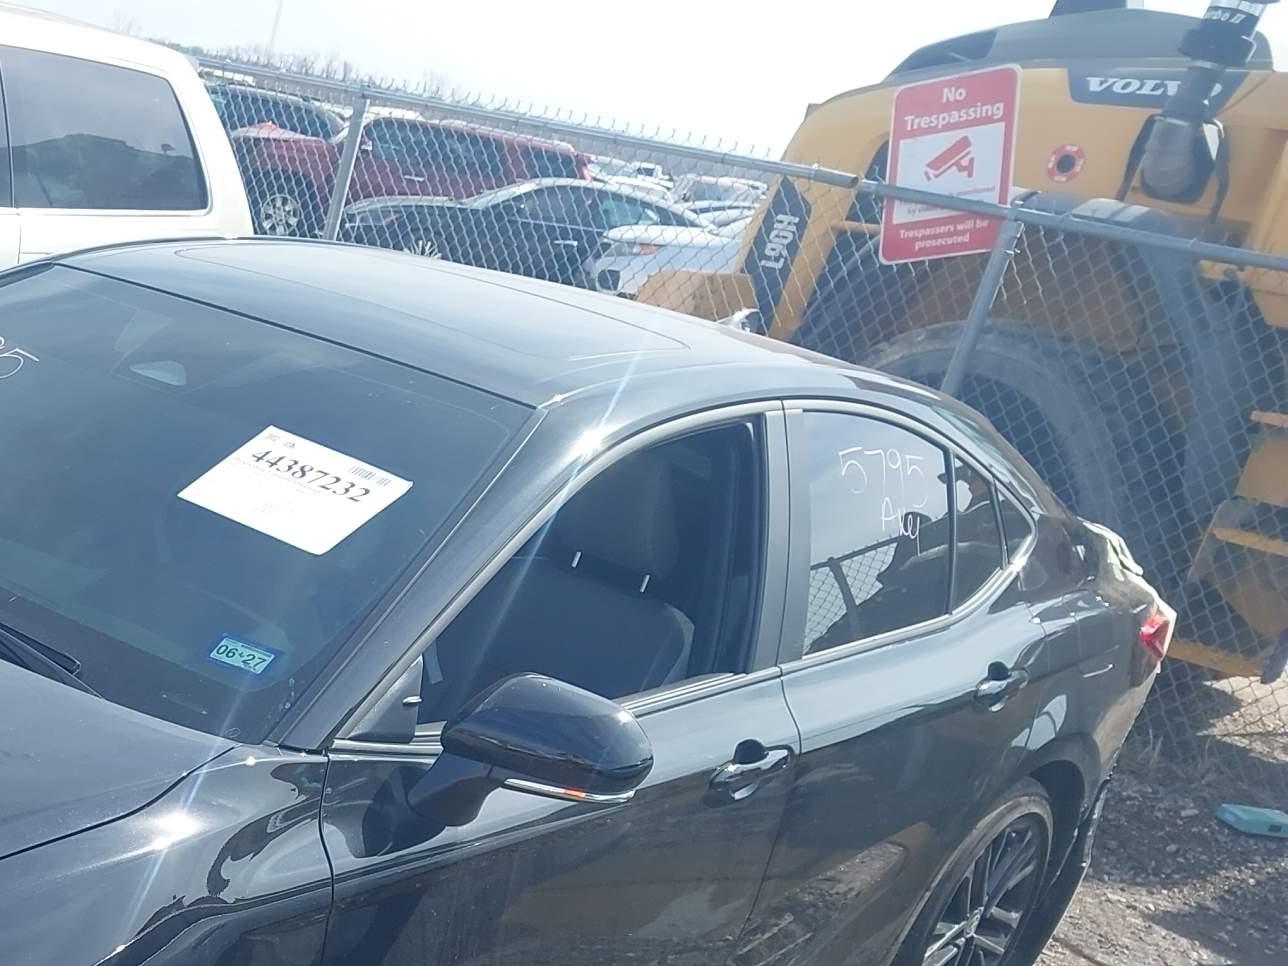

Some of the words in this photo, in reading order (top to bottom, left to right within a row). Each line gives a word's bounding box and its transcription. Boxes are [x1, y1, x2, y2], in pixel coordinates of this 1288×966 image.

[942, 86, 967, 103] No
[903, 102, 1005, 131] Trespassing
[899, 223, 955, 240] Trespassers
[955, 218, 974, 231] will
[914, 231, 970, 251] prosecuted
[251, 450, 371, 502] 44387232
[838, 446, 929, 508] 5795
